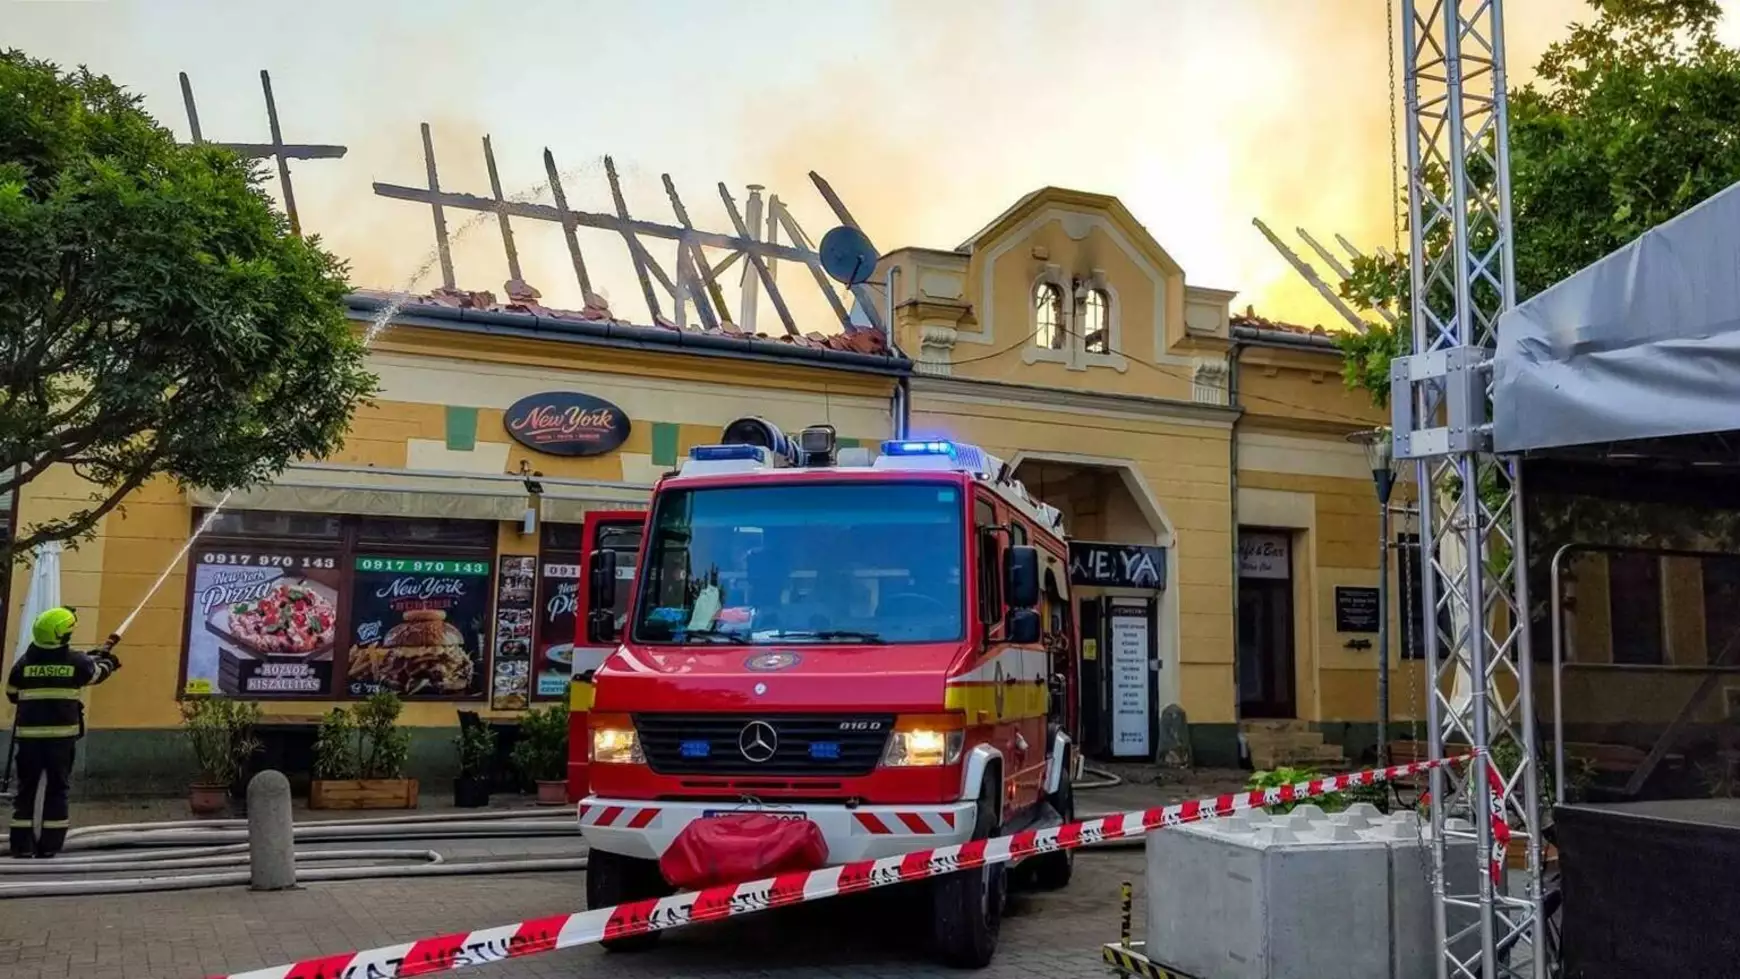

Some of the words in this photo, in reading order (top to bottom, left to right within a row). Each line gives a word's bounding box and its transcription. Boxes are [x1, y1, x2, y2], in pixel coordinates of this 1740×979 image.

[511, 405, 564, 430] New
[562, 406, 616, 433] York
[203, 553, 251, 565] 0917
[258, 555, 293, 567] 970
[302, 557, 335, 568] 143
[362, 560, 404, 570] 0917
[413, 561, 444, 572] 970
[454, 563, 483, 573] 143
[213, 571, 238, 584] New
[239, 569, 266, 582] York
[376, 577, 421, 598] New
[419, 577, 466, 599] York
[201, 581, 273, 615] Pizza
[870, 722, 881, 730] D
